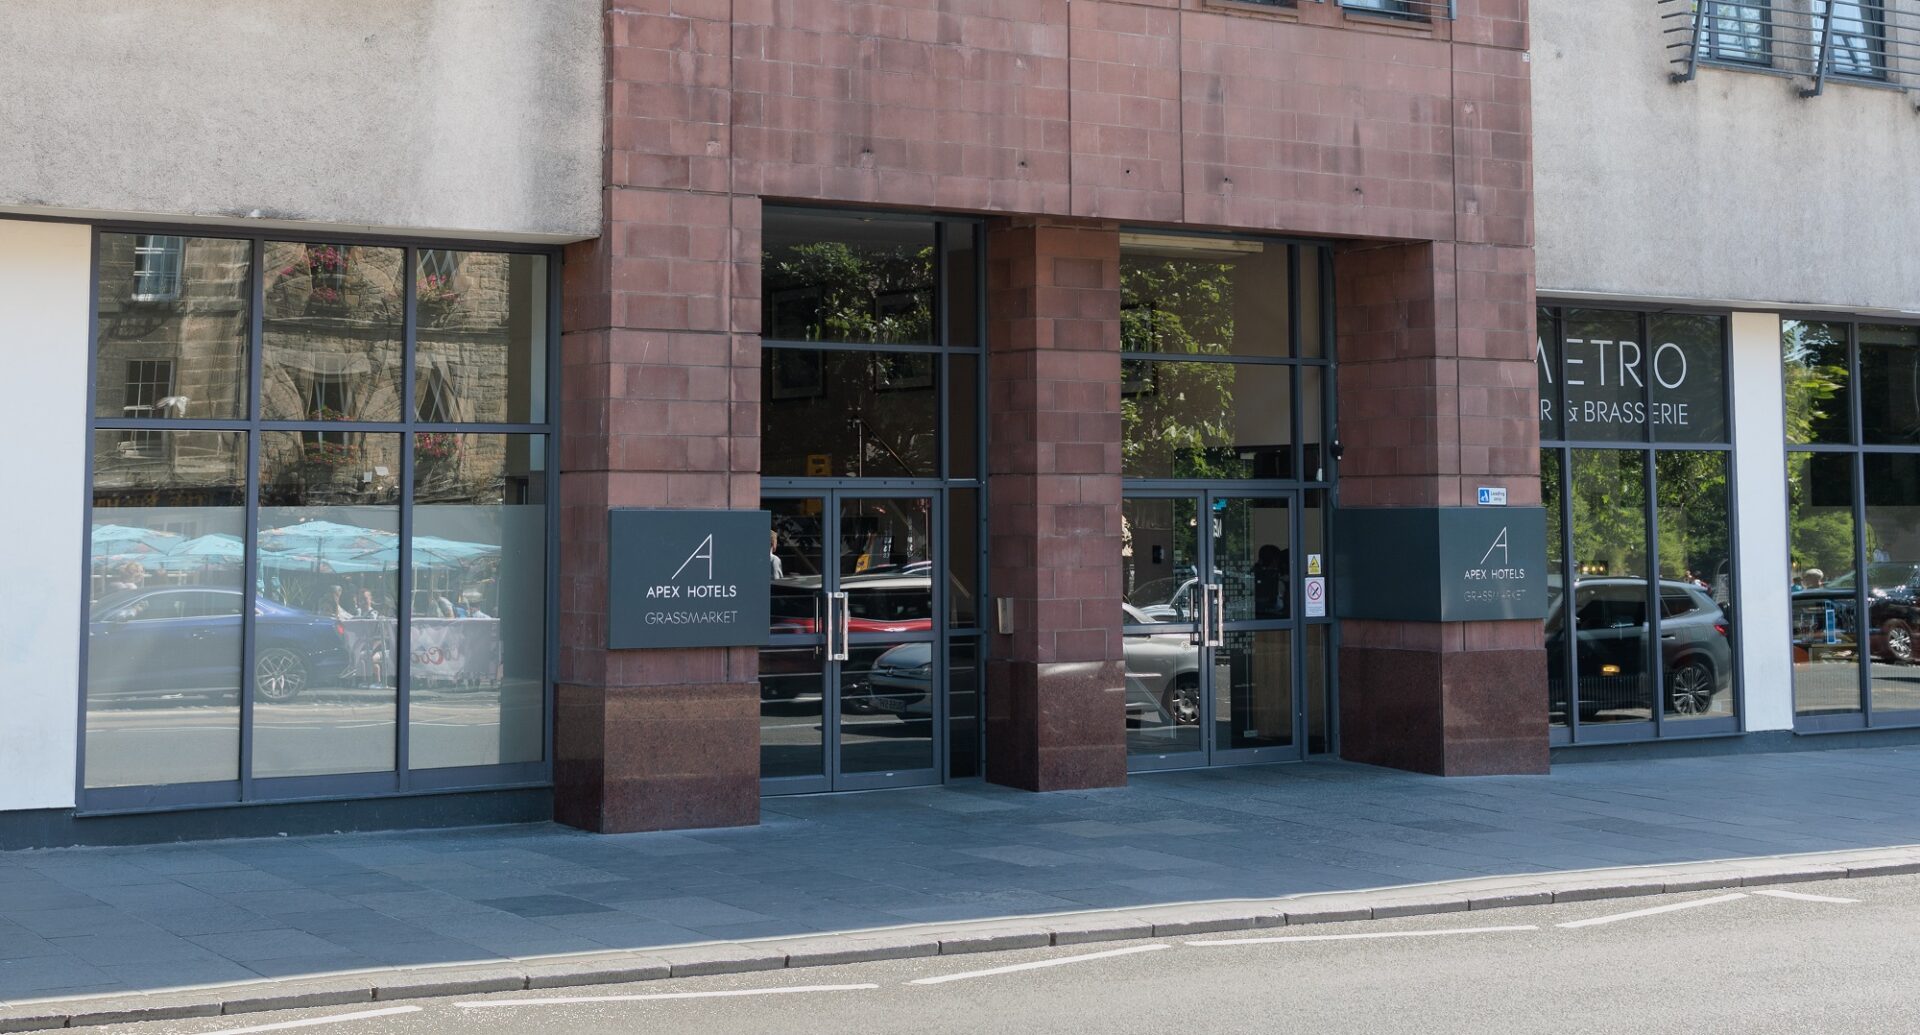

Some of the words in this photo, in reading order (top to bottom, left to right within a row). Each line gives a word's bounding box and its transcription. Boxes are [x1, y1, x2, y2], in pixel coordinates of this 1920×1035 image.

[1584, 400, 1689, 425] BRASSERIE
[1463, 569, 1487, 580] APEX
[1491, 568, 1525, 579] HOTELS
[646, 585, 680, 599] APEX
[687, 584, 737, 598] HOTELS
[644, 610, 738, 625] GRASSMARKET
